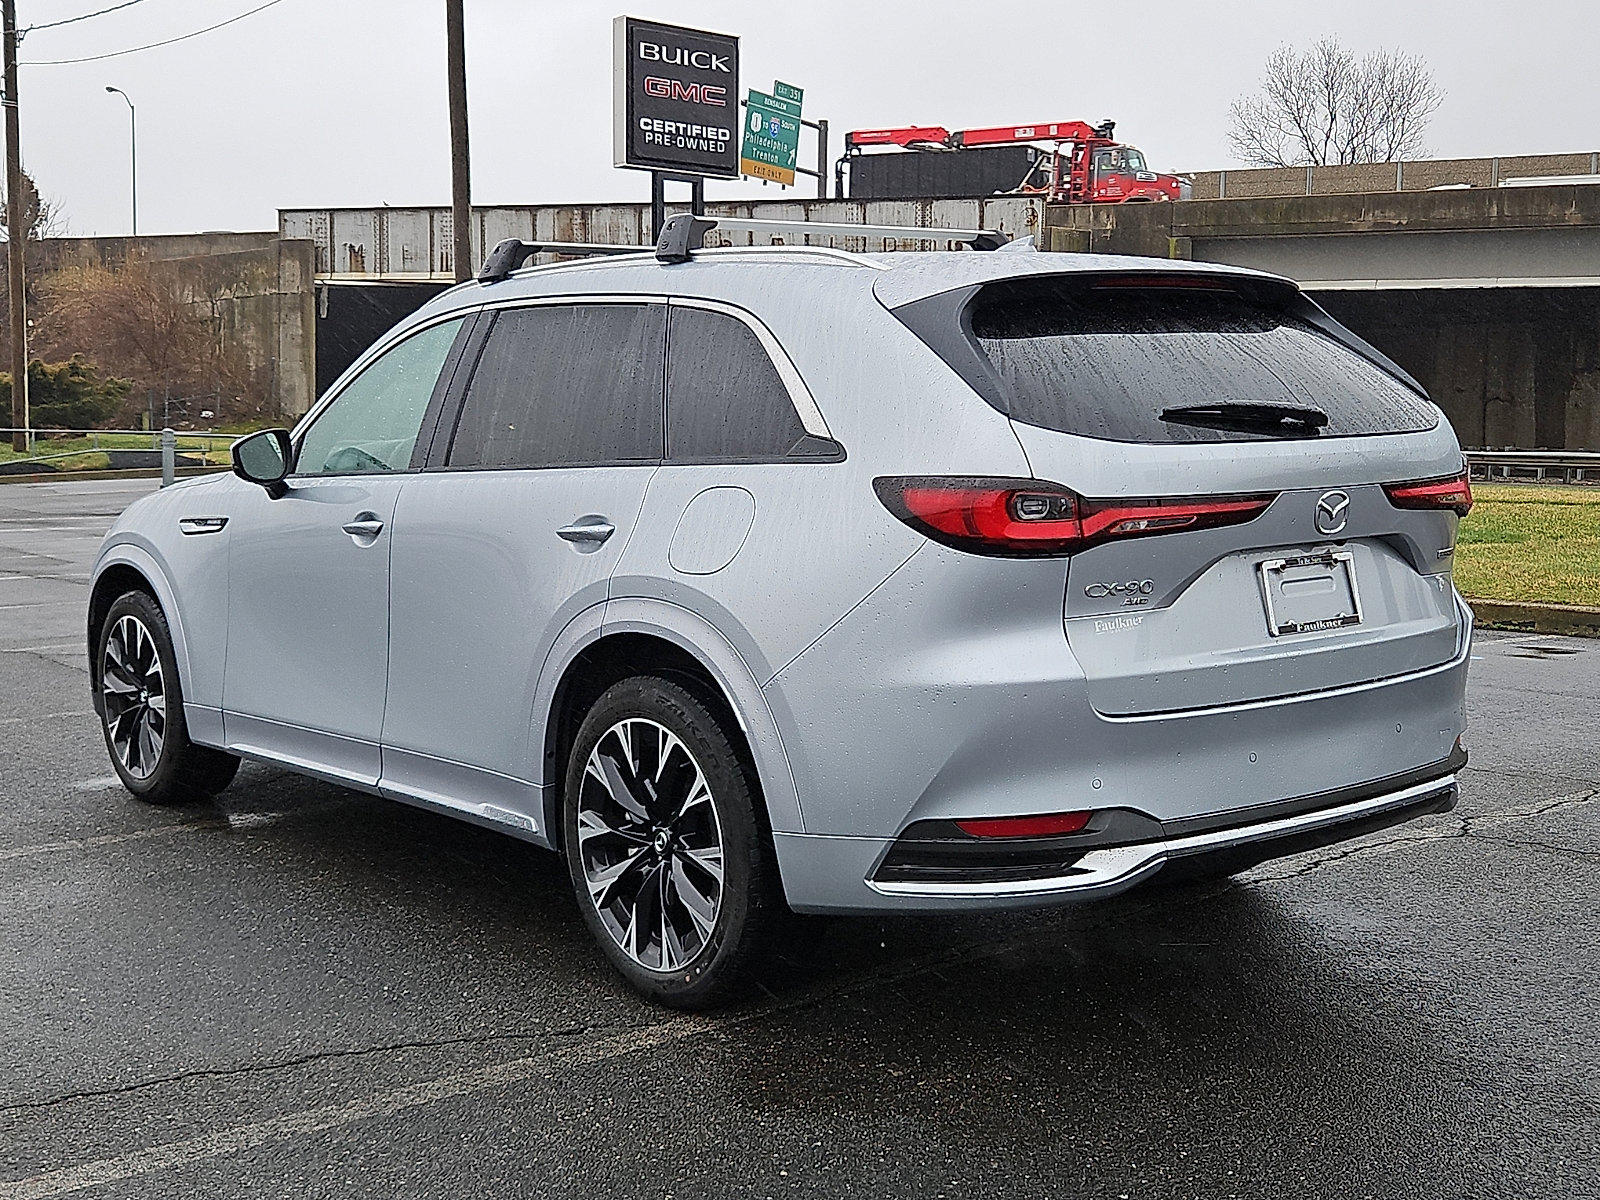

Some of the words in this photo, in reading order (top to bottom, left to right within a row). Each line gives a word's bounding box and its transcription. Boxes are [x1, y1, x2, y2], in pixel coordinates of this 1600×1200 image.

[639, 41, 731, 73] BUICK
[644, 76, 726, 107] GMC
[778, 85, 787, 95] EXIT
[790, 89, 800, 101] 351
[764, 98, 787, 110] BENSALEM
[639, 117, 731, 141] CERTIFIED
[770, 124, 779, 134] 95
[645, 132, 726, 153] PRE-OWNED
[745, 132, 788, 152] Philadelphia
[752, 147, 779, 163] Trenton
[753, 165, 766, 176] EXIT
[767, 168, 783, 179] ONLY
[1084, 578, 1154, 598] CX-90
[1094, 616, 1144, 633] Faulkner
[1297, 619, 1344, 633] Faulkner
